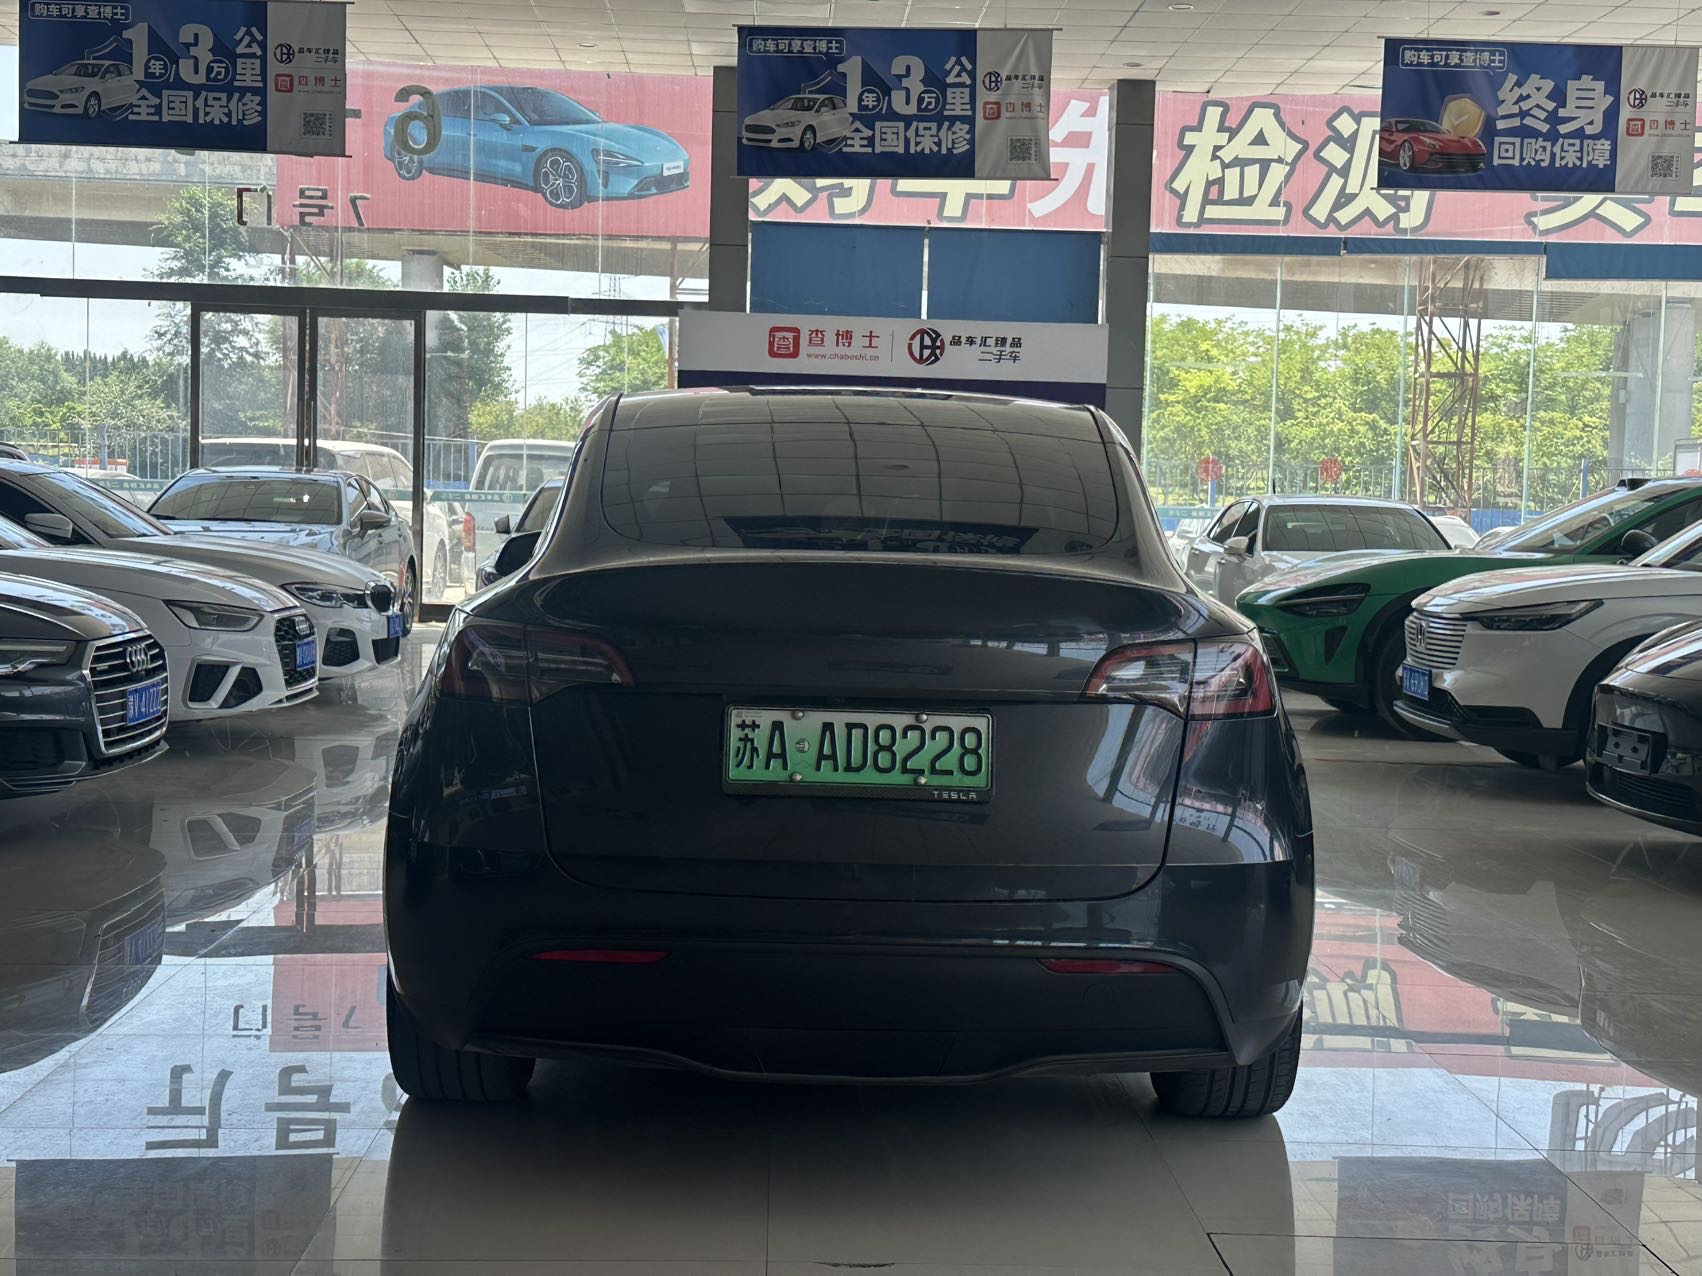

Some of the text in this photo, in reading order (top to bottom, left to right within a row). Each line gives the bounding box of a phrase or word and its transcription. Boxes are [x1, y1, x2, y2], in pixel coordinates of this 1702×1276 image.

[34, 4, 126, 20] 购车可享查博士
[752, 39, 840, 54] 购车可享查博士
[1404, 49, 1505, 68] 购车可享查博士
[128, 90, 264, 127] 全国保修
[1495, 73, 1615, 135] 终身
[842, 120, 971, 154] 全国保修
[1492, 137, 1612, 169] 回购保障
[807, 328, 880, 349] 查博士
[806, 352, 880, 362] www.chaboshi.cn
[933, 791, 977, 799] TESLA
